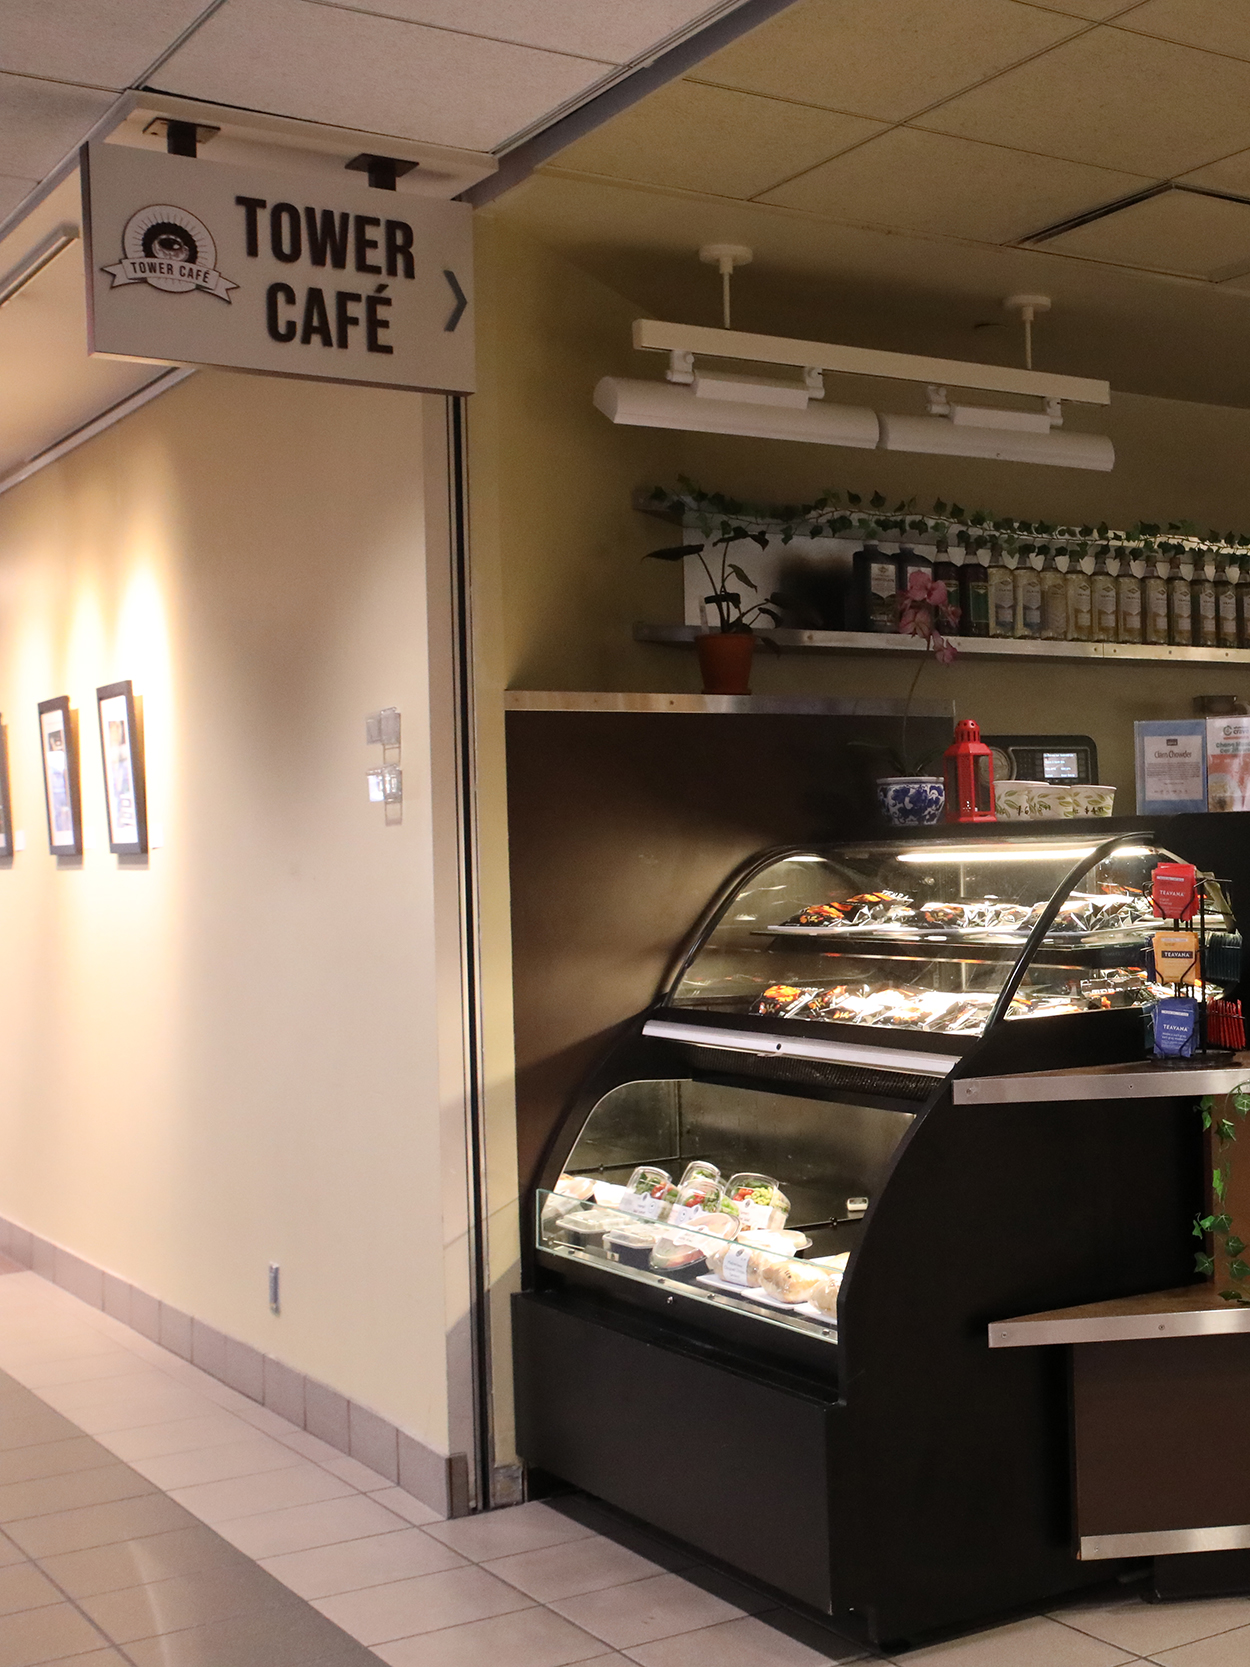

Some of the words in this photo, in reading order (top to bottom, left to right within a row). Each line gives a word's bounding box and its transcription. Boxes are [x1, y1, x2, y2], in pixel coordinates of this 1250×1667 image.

[130, 261, 174, 276] TOWER
[179, 264, 211, 284] CAFÉ
[235, 196, 415, 280] TOWER
[266, 283, 394, 355] CAFÉ
